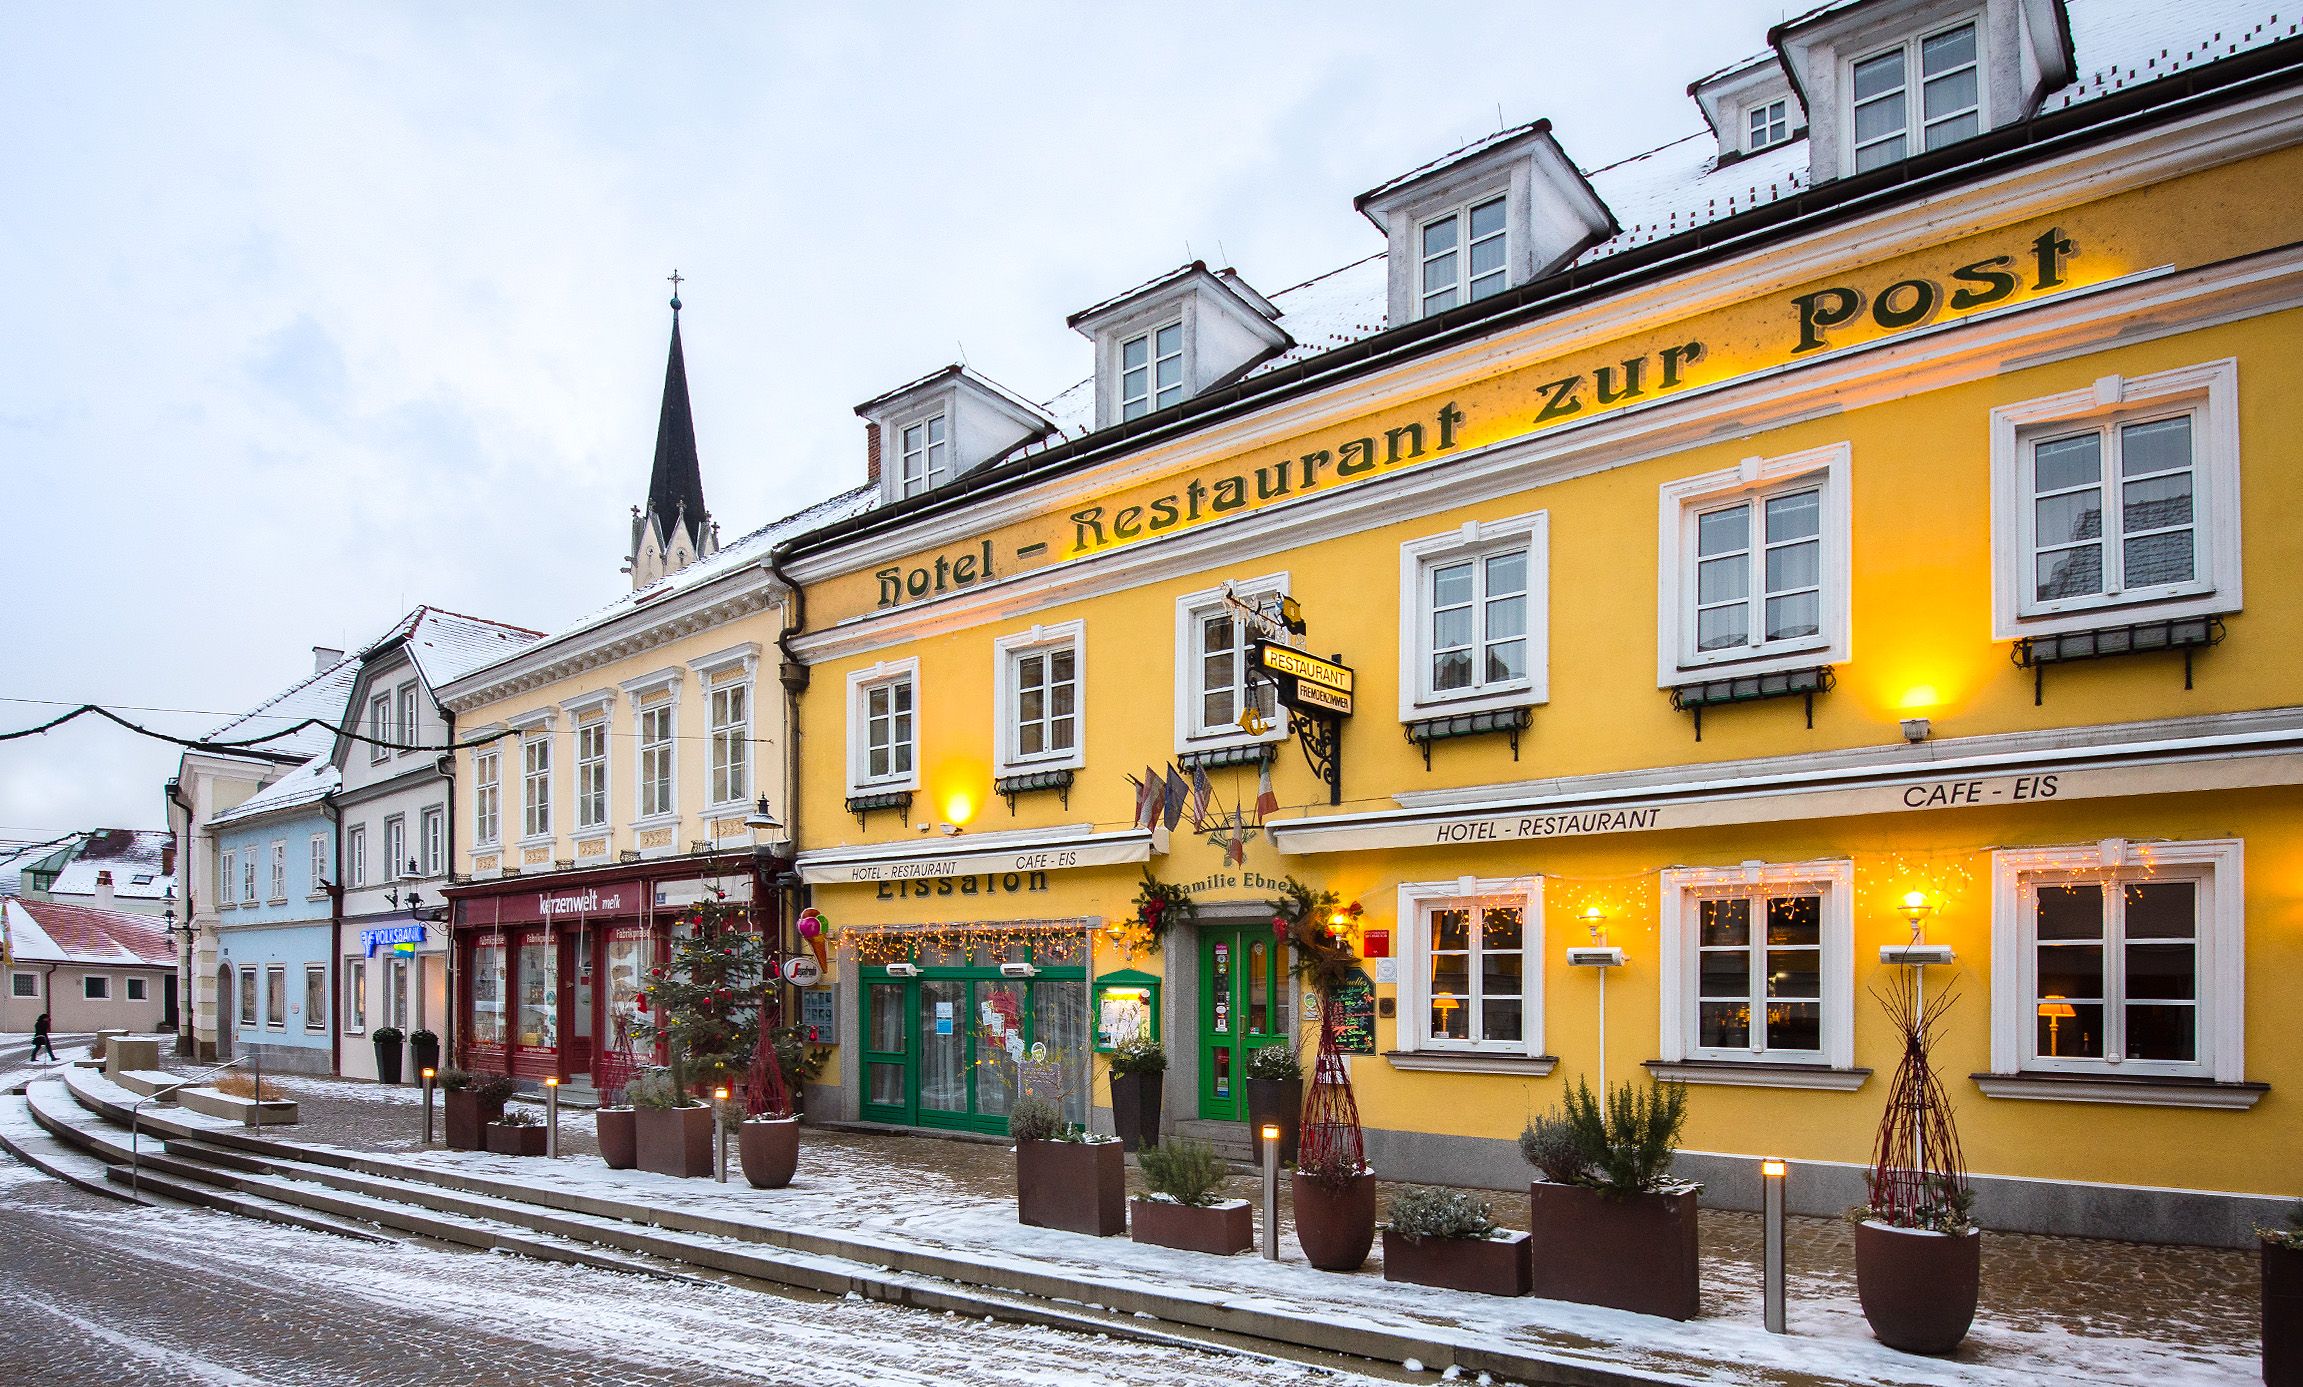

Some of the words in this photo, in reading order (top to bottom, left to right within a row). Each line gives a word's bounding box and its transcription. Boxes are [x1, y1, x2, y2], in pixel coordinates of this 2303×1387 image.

[1071, 401, 1464, 553] Restaurant
[1533, 340, 1704, 424] zur
[1270, 651, 1345, 686] RESTAURANT
[1300, 684, 1349, 709] FREMDENZIMMER
[1903, 781, 1983, 807] CAFE
[2013, 775, 2058, 799] EIS
[1436, 821, 1497, 842] HOTEL
[1518, 808, 1661, 836] RESTAURANT
[852, 866, 881, 880] HOTEL
[891, 861, 957, 879] RESTAURANT
[1015, 854, 1048, 870] CAFE
[1058, 851, 1076, 866] EIS
[539, 888, 598, 915] kerzenwelt
[602, 893, 621, 910] melk
[375, 926, 420, 944] VOLKSBANK
